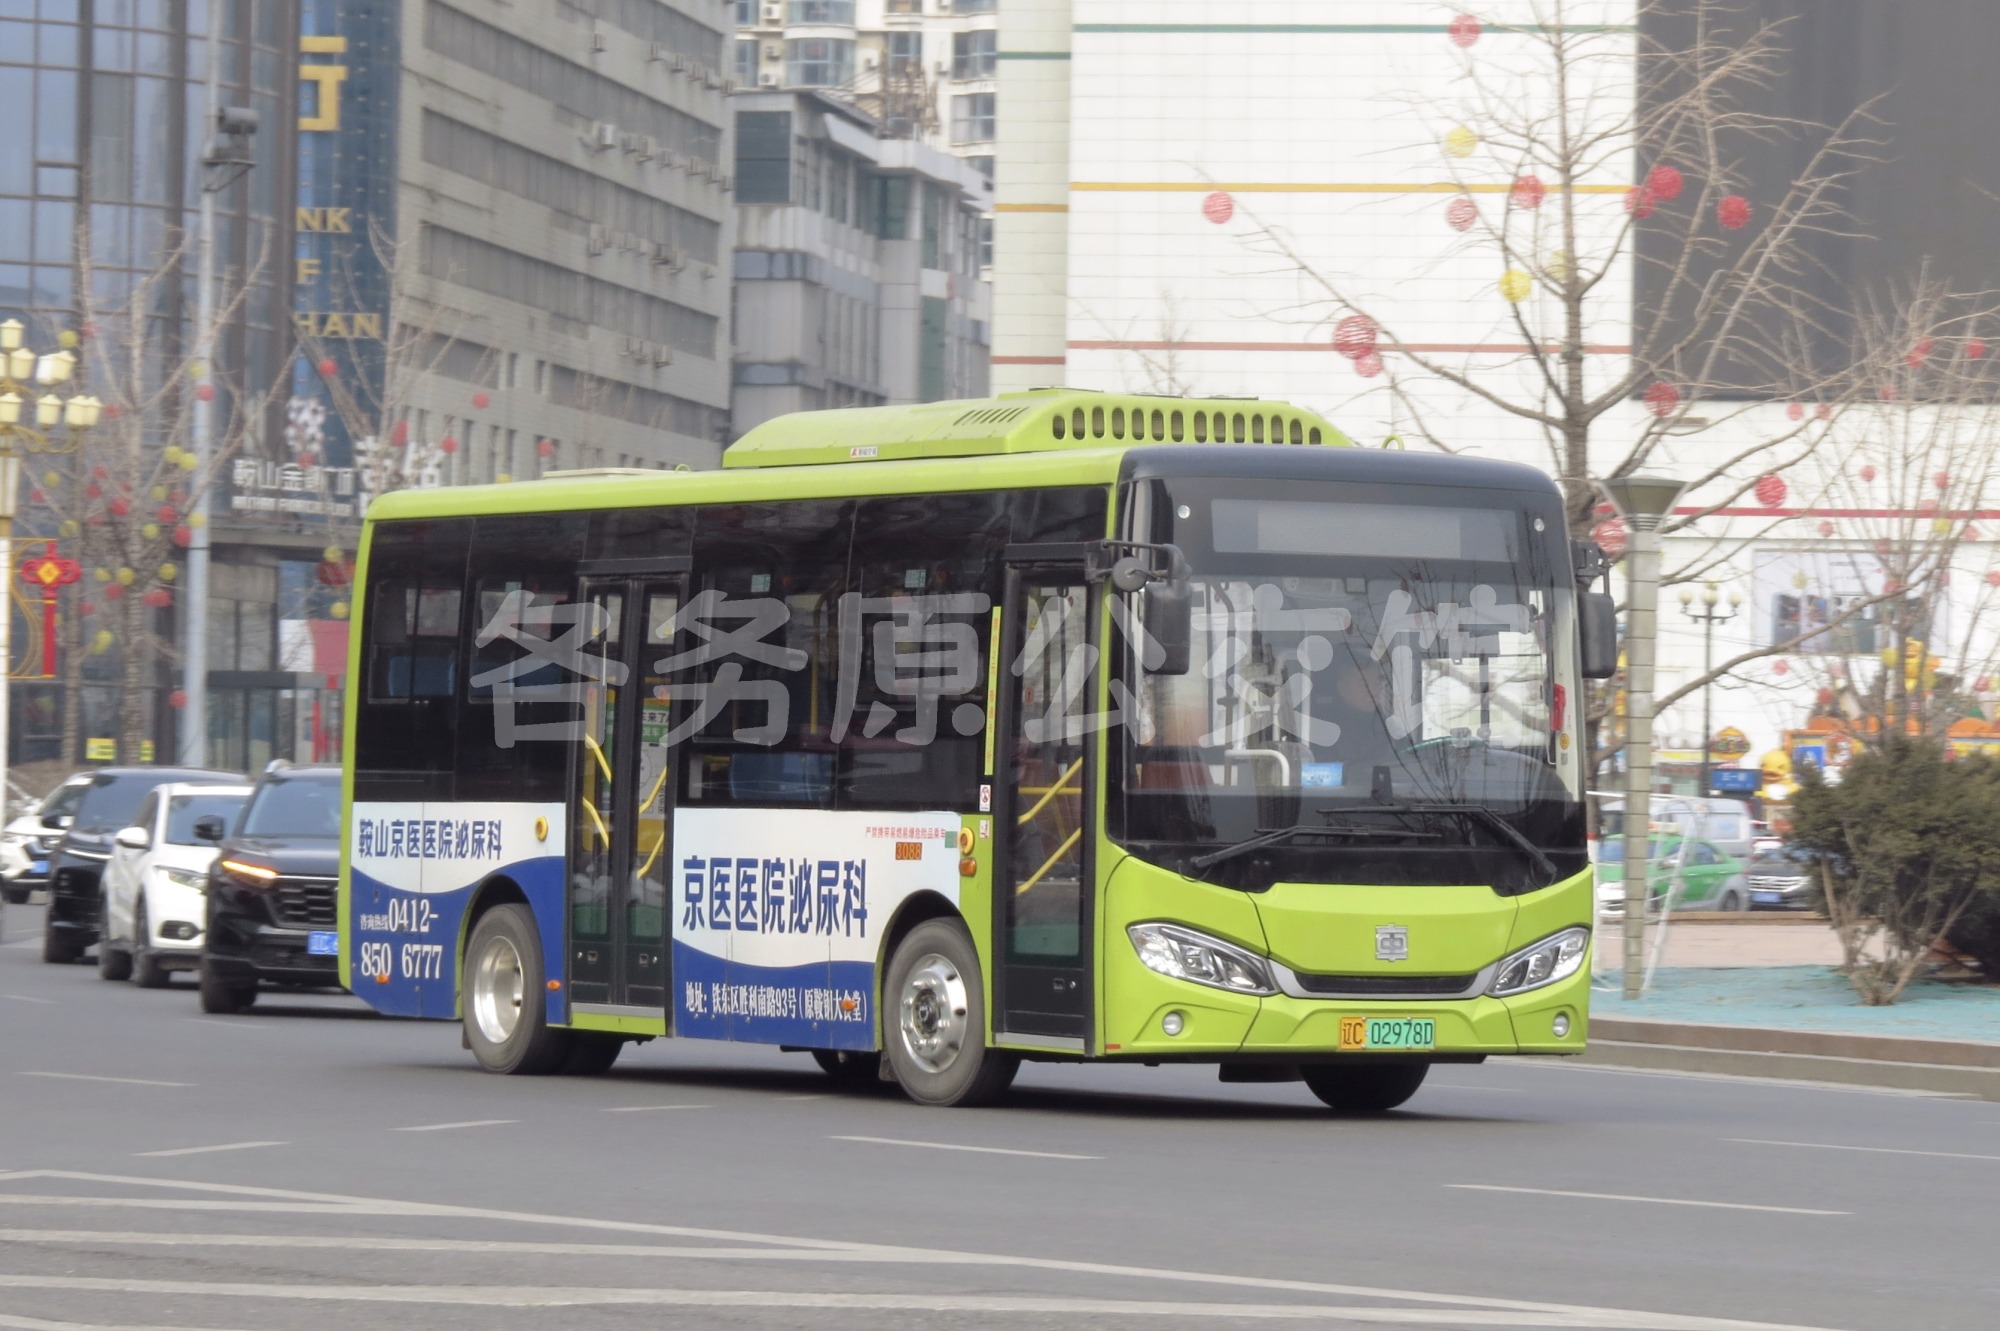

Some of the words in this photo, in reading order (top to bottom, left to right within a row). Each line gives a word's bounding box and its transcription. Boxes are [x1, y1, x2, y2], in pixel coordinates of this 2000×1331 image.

[358, 818, 503, 861] 鞍山京医医院泌尿科
[895, 842, 922, 860] 3088
[682, 855, 868, 938] 京医医院泌尿科
[361, 942, 392, 976] 850
[401, 943, 443, 979] 6777
